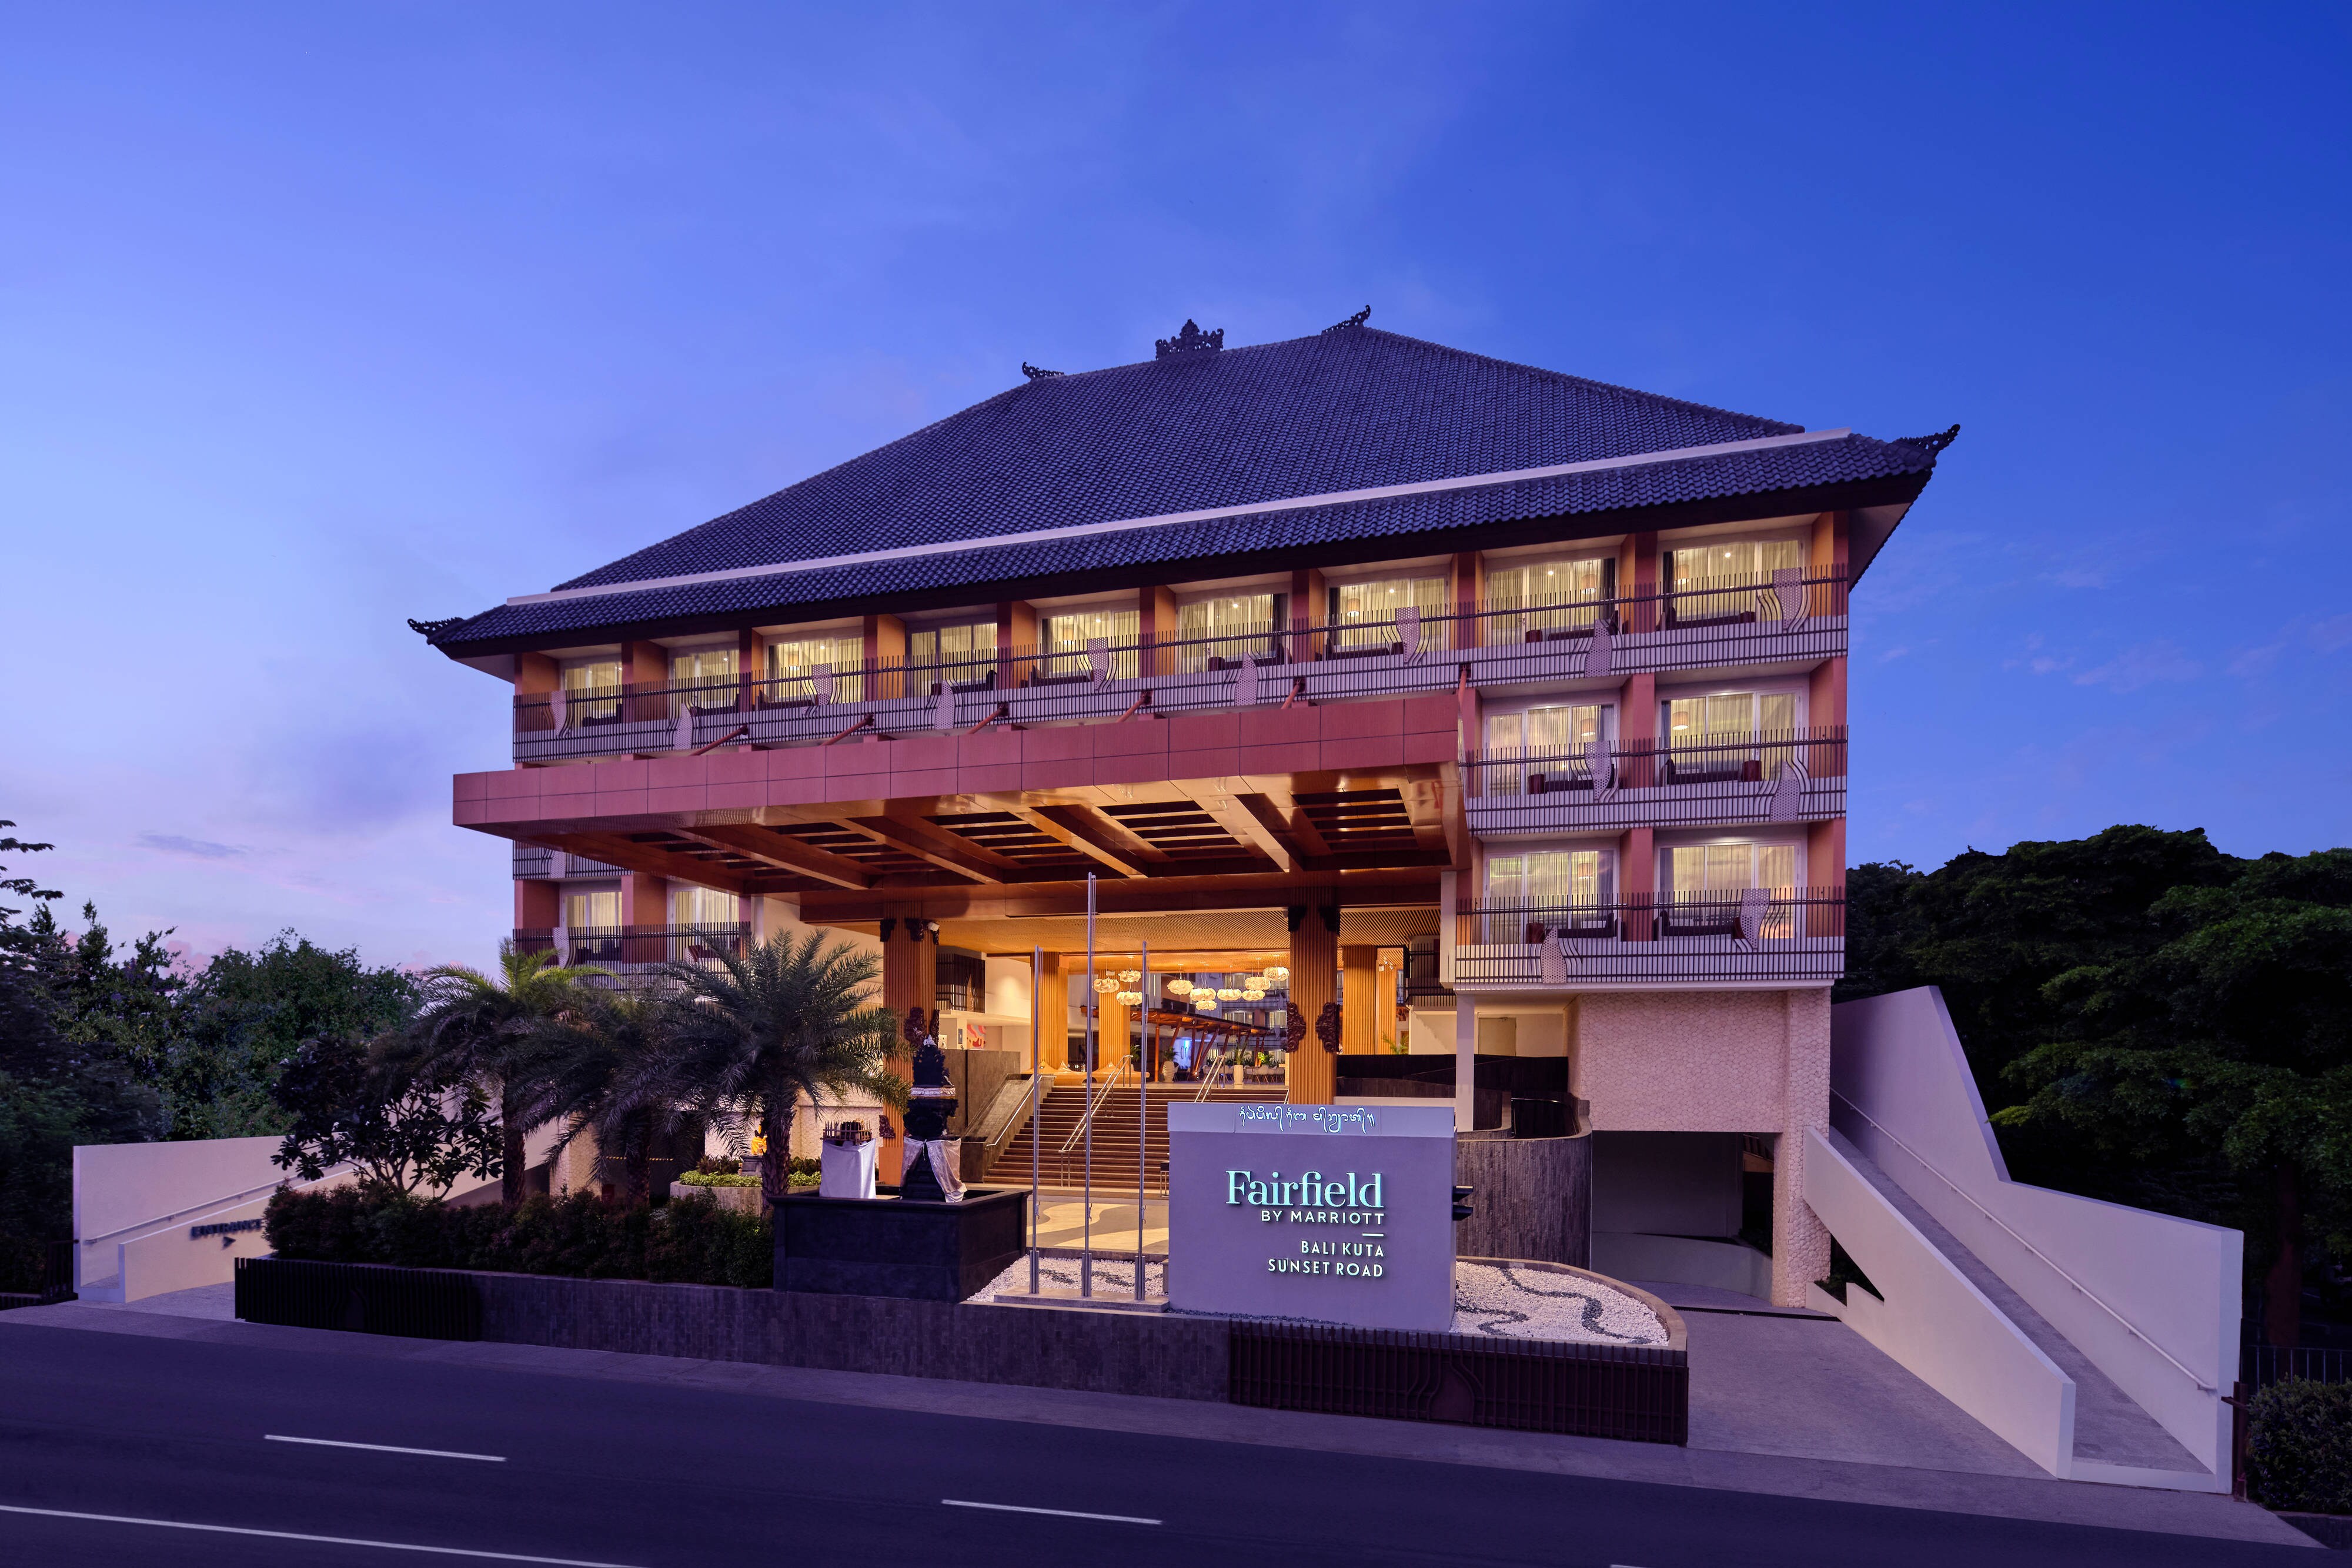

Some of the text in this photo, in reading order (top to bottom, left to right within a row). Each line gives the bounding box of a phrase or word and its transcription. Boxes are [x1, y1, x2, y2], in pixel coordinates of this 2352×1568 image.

[1225, 1171, 1384, 1208] Fairfield
[1261, 1210, 1384, 1225] BY MARRIOTT
[1301, 1241, 1384, 1257] BALI KUTA
[1268, 1258, 1383, 1277] SUNSET ROAD
